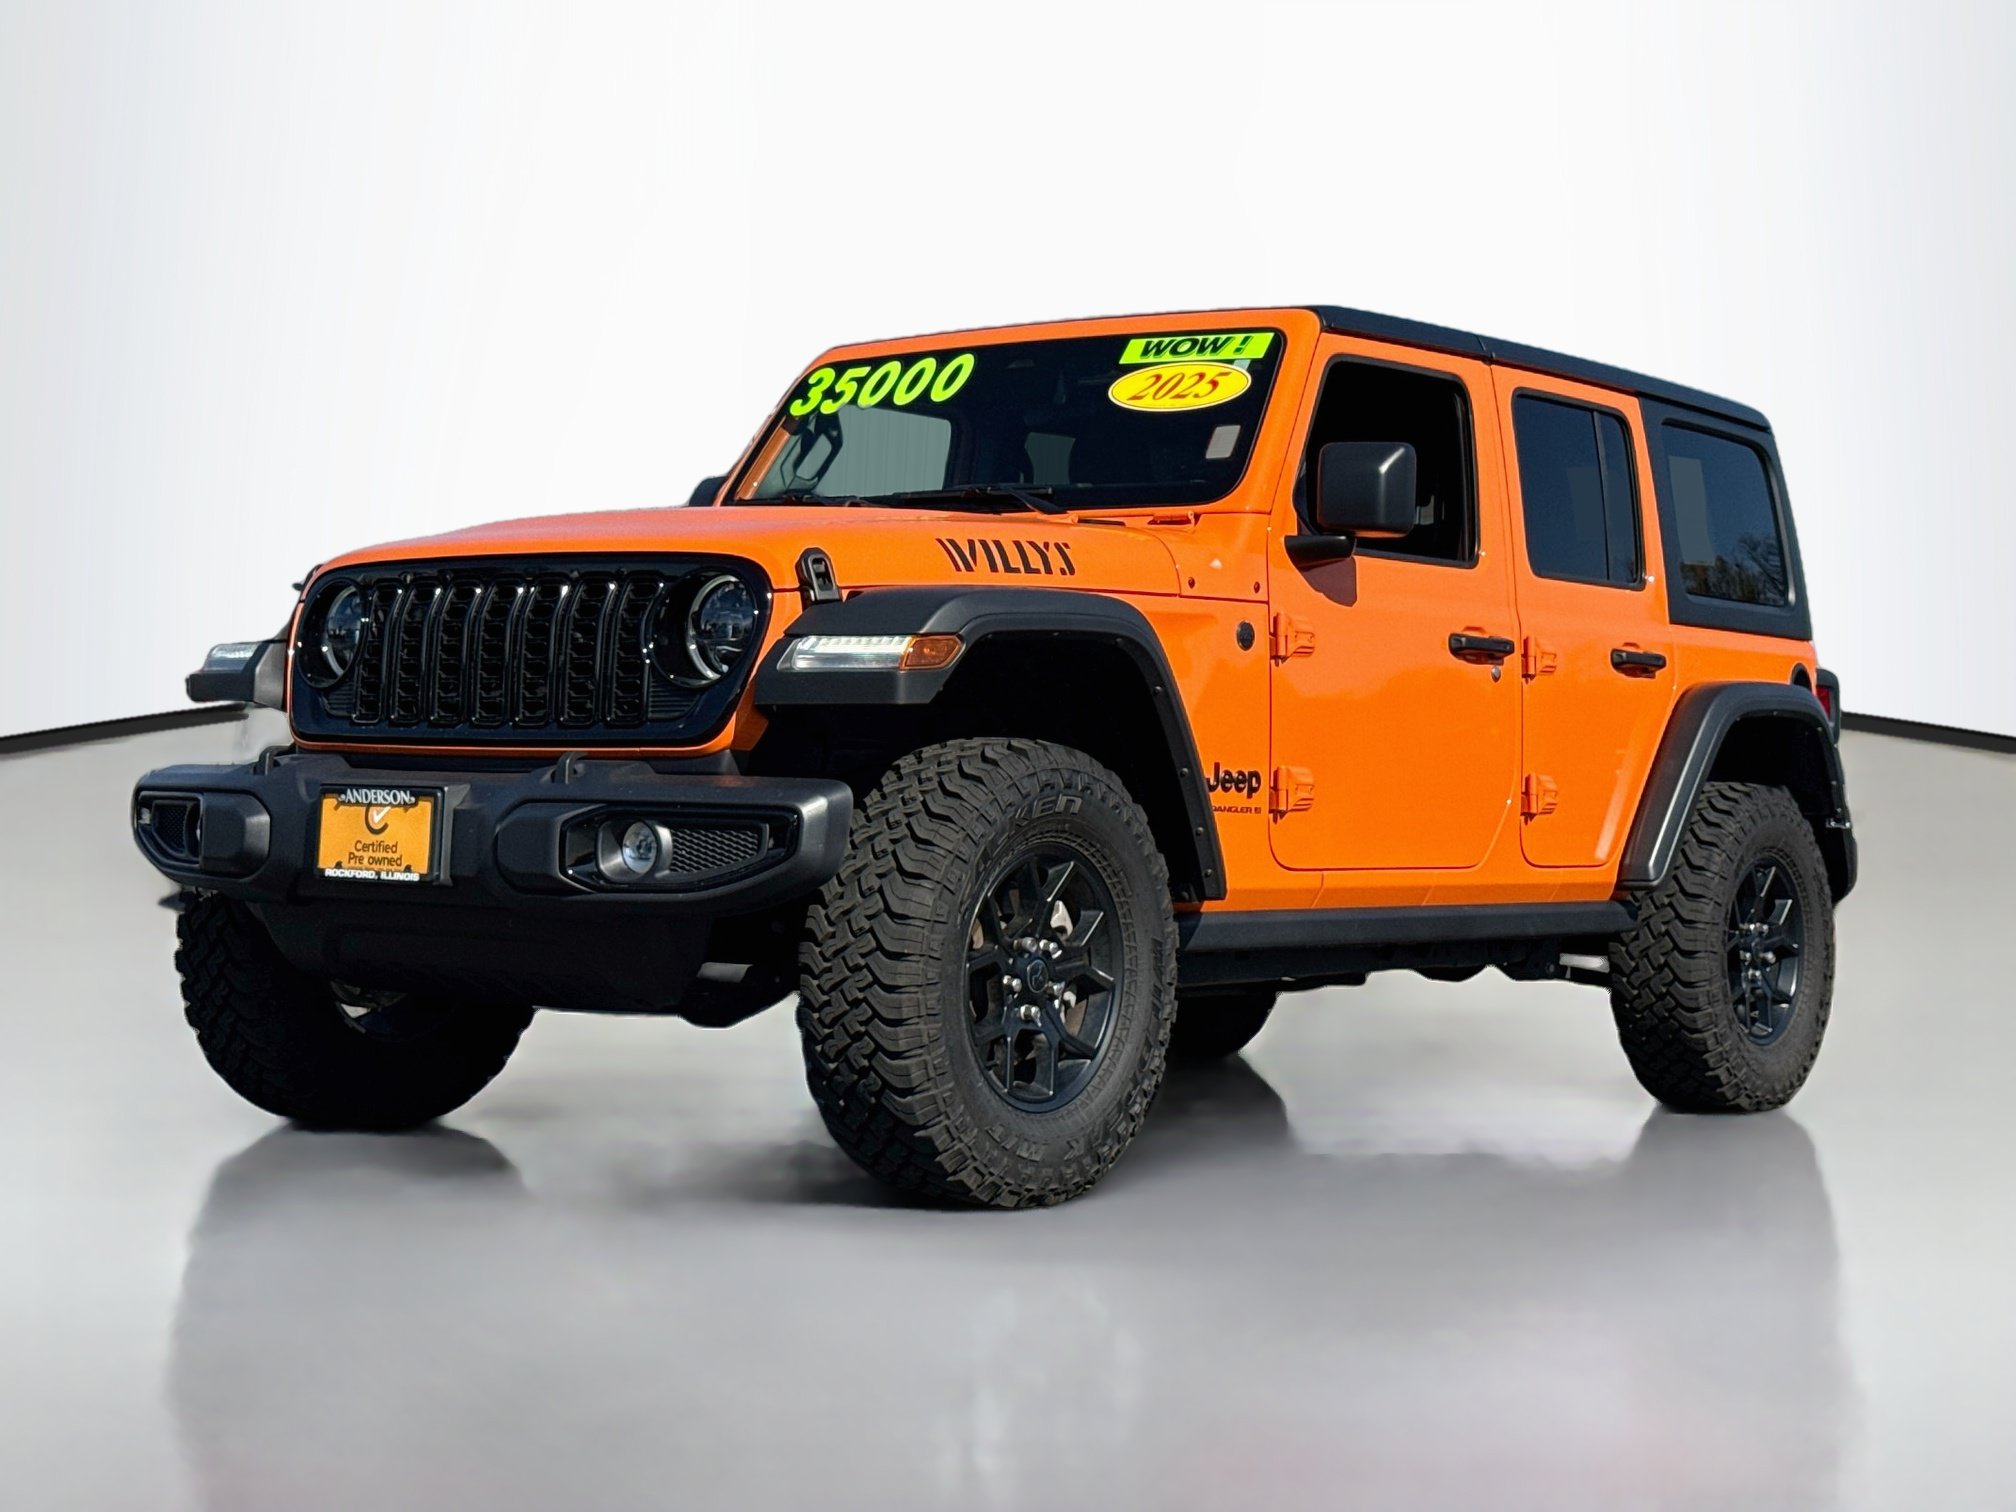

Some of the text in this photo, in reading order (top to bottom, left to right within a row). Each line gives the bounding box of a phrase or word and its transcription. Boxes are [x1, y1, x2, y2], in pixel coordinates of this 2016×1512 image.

[789, 353, 975, 416] 35000
[1126, 371, 1233, 401] 2025
[935, 538, 1076, 576] WILLYS
[1206, 762, 1262, 799] Jeep
[344, 788, 412, 805] ANDERSON
[354, 840, 399, 854] Certified
[347, 852, 403, 867] Pre owned
[324, 868, 379, 880] ROCKFORD,
[380, 870, 420, 881] ILLINOIS
